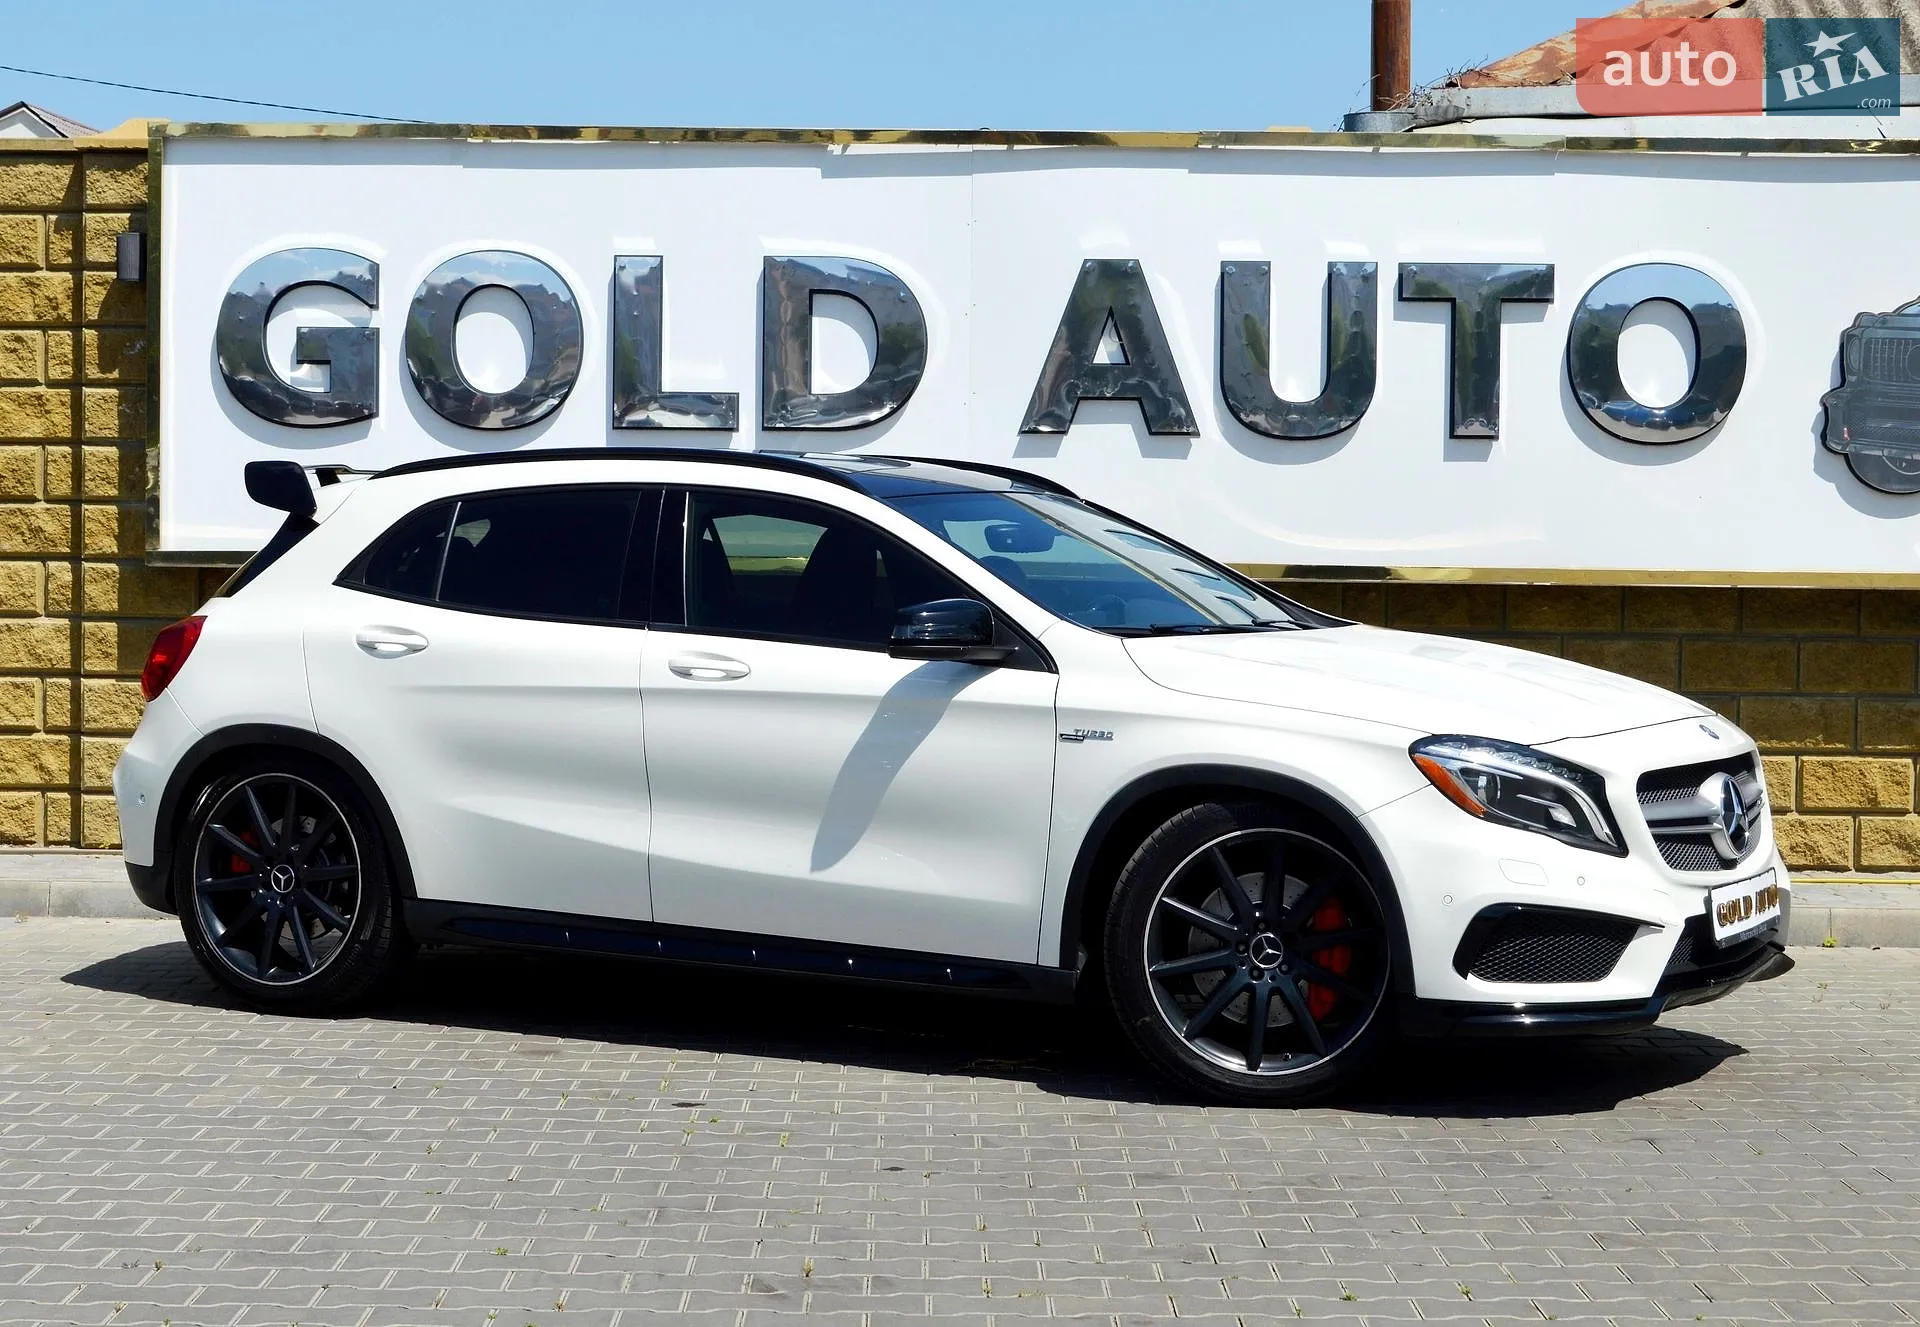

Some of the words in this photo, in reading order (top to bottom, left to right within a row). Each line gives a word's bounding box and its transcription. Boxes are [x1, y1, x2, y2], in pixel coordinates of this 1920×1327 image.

[217, 246, 928, 431] GOLD
[1017, 257, 1748, 446] AUTO
[1074, 728, 1114, 738] TURBO
[1716, 895, 1753, 928] GOLD
